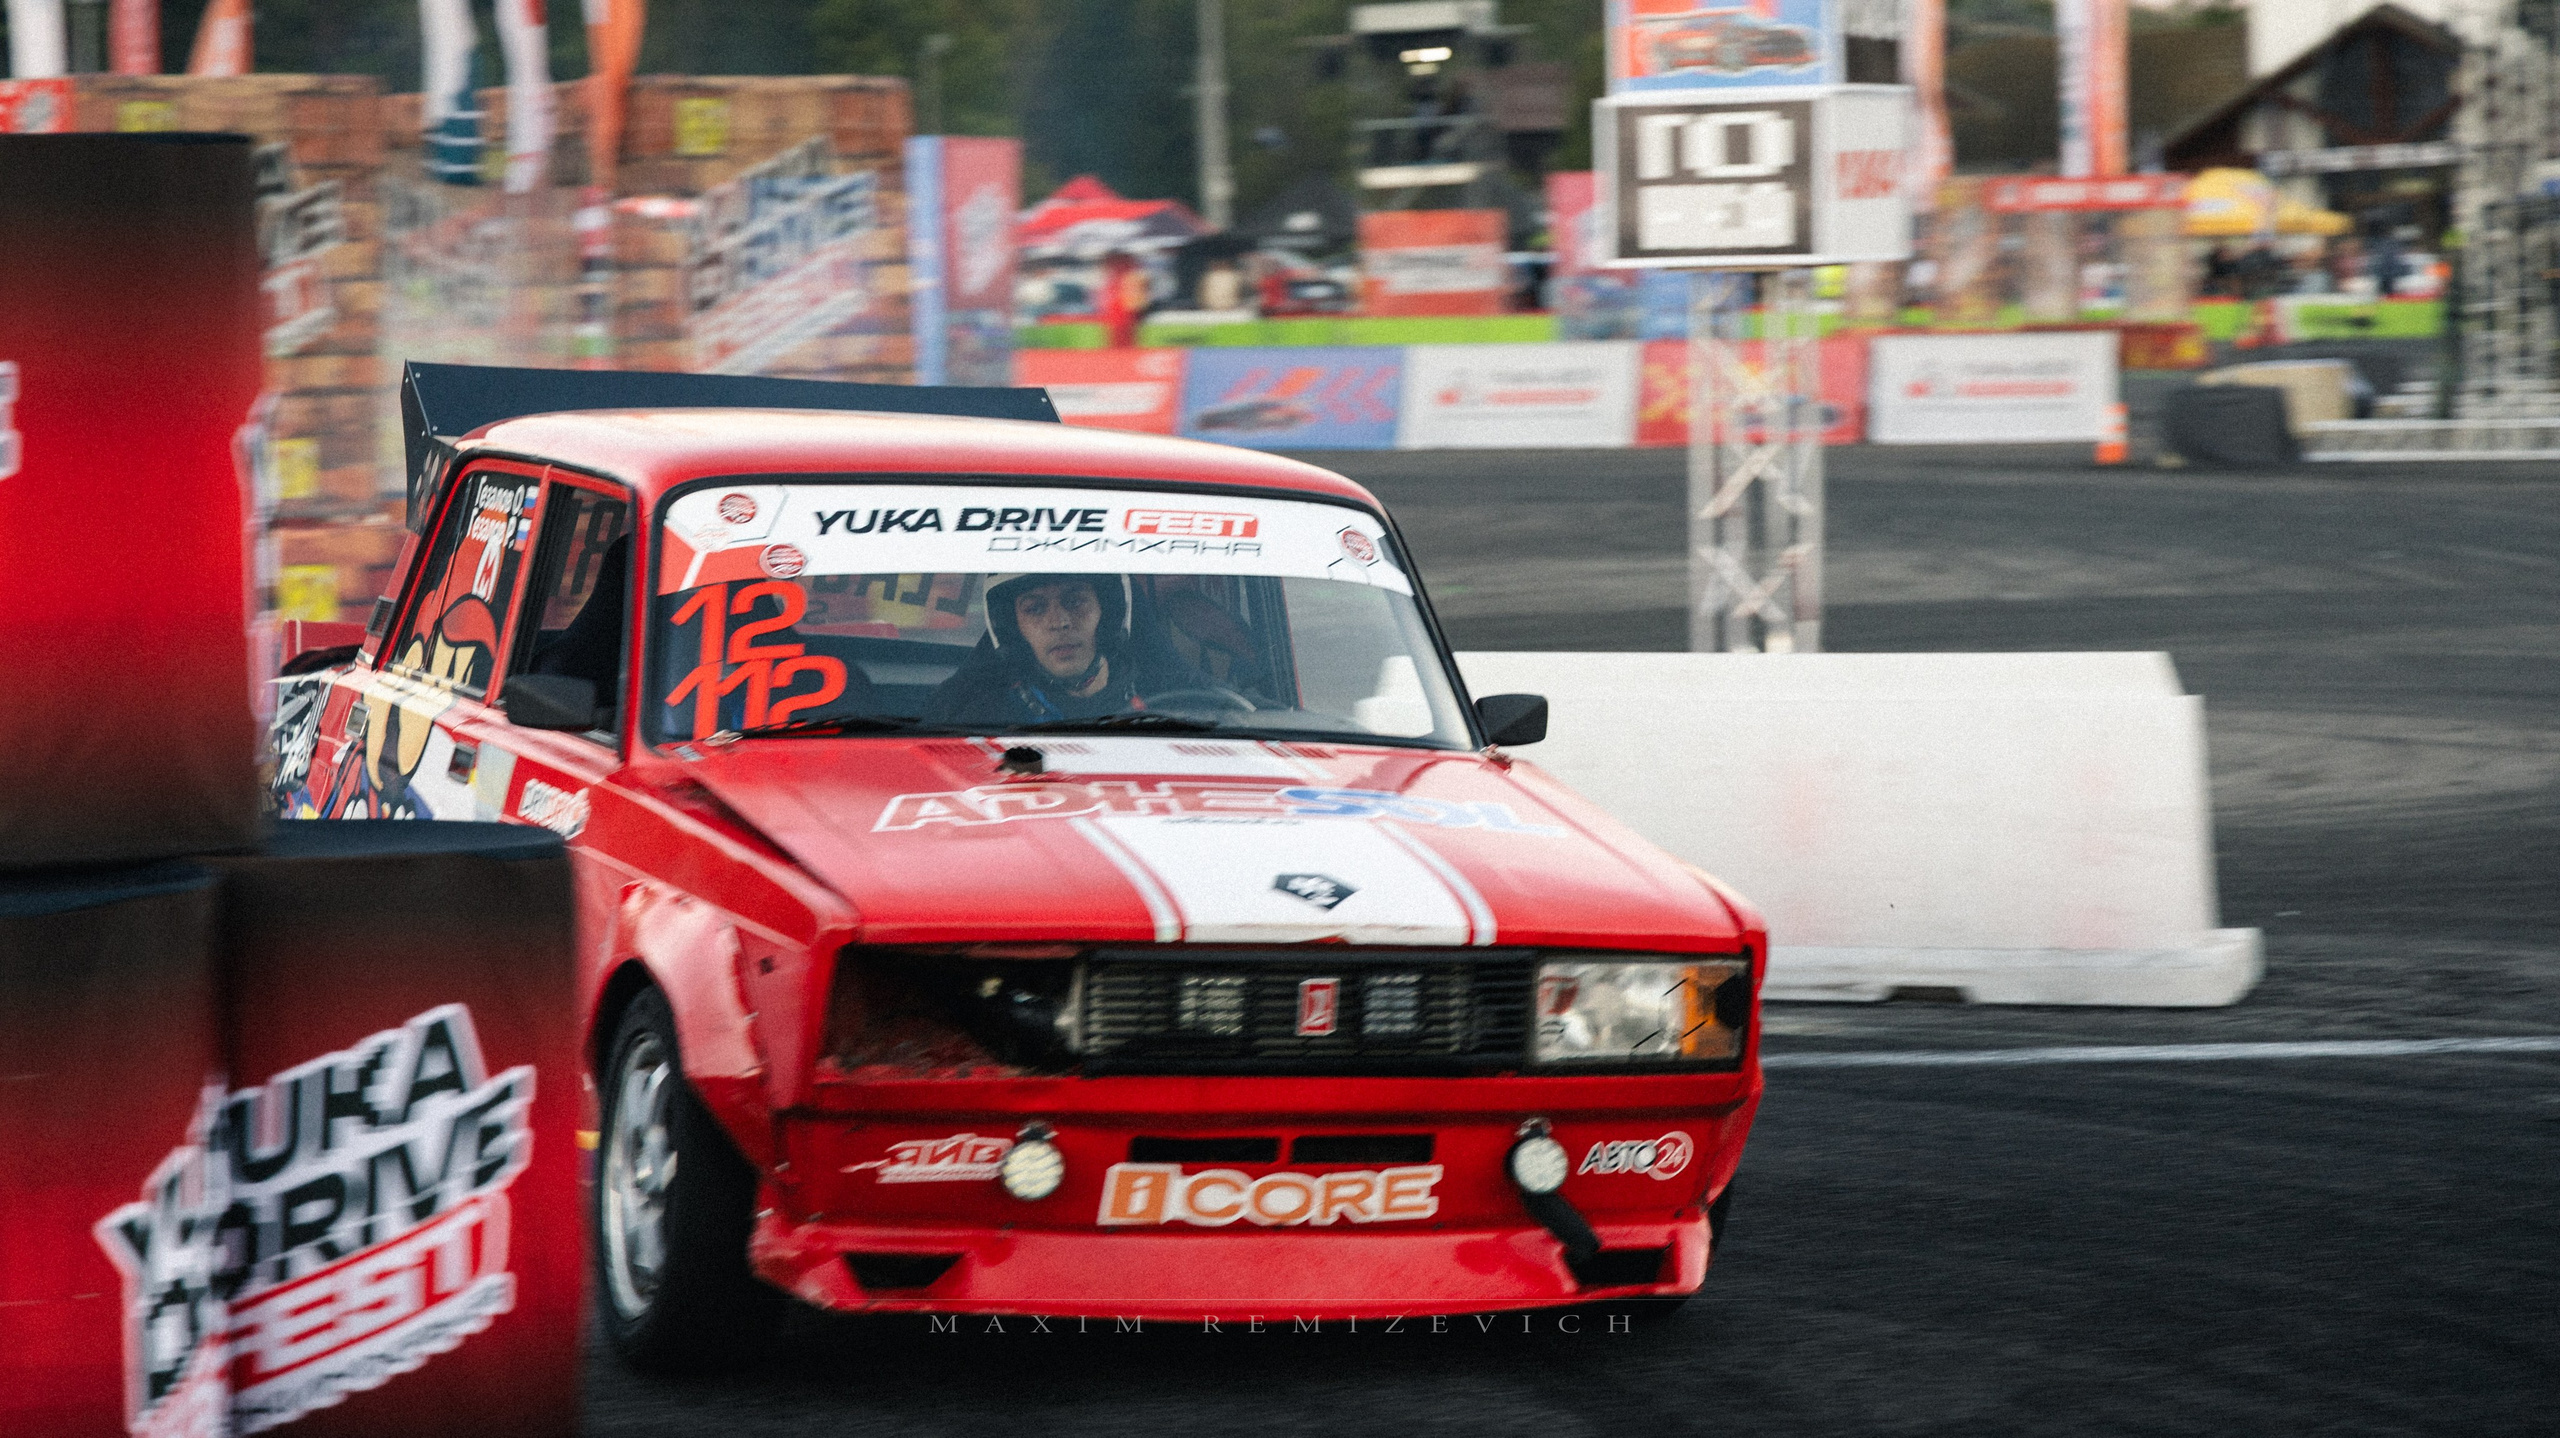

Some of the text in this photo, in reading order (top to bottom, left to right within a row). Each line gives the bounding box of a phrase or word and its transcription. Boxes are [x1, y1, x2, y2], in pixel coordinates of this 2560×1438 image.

[814, 507, 1257, 537] YUKA DRIVE FEST
[987, 536, 1262, 558] ДЖИМХАНА
[669, 580, 807, 665] 12
[664, 654, 848, 740] 112
